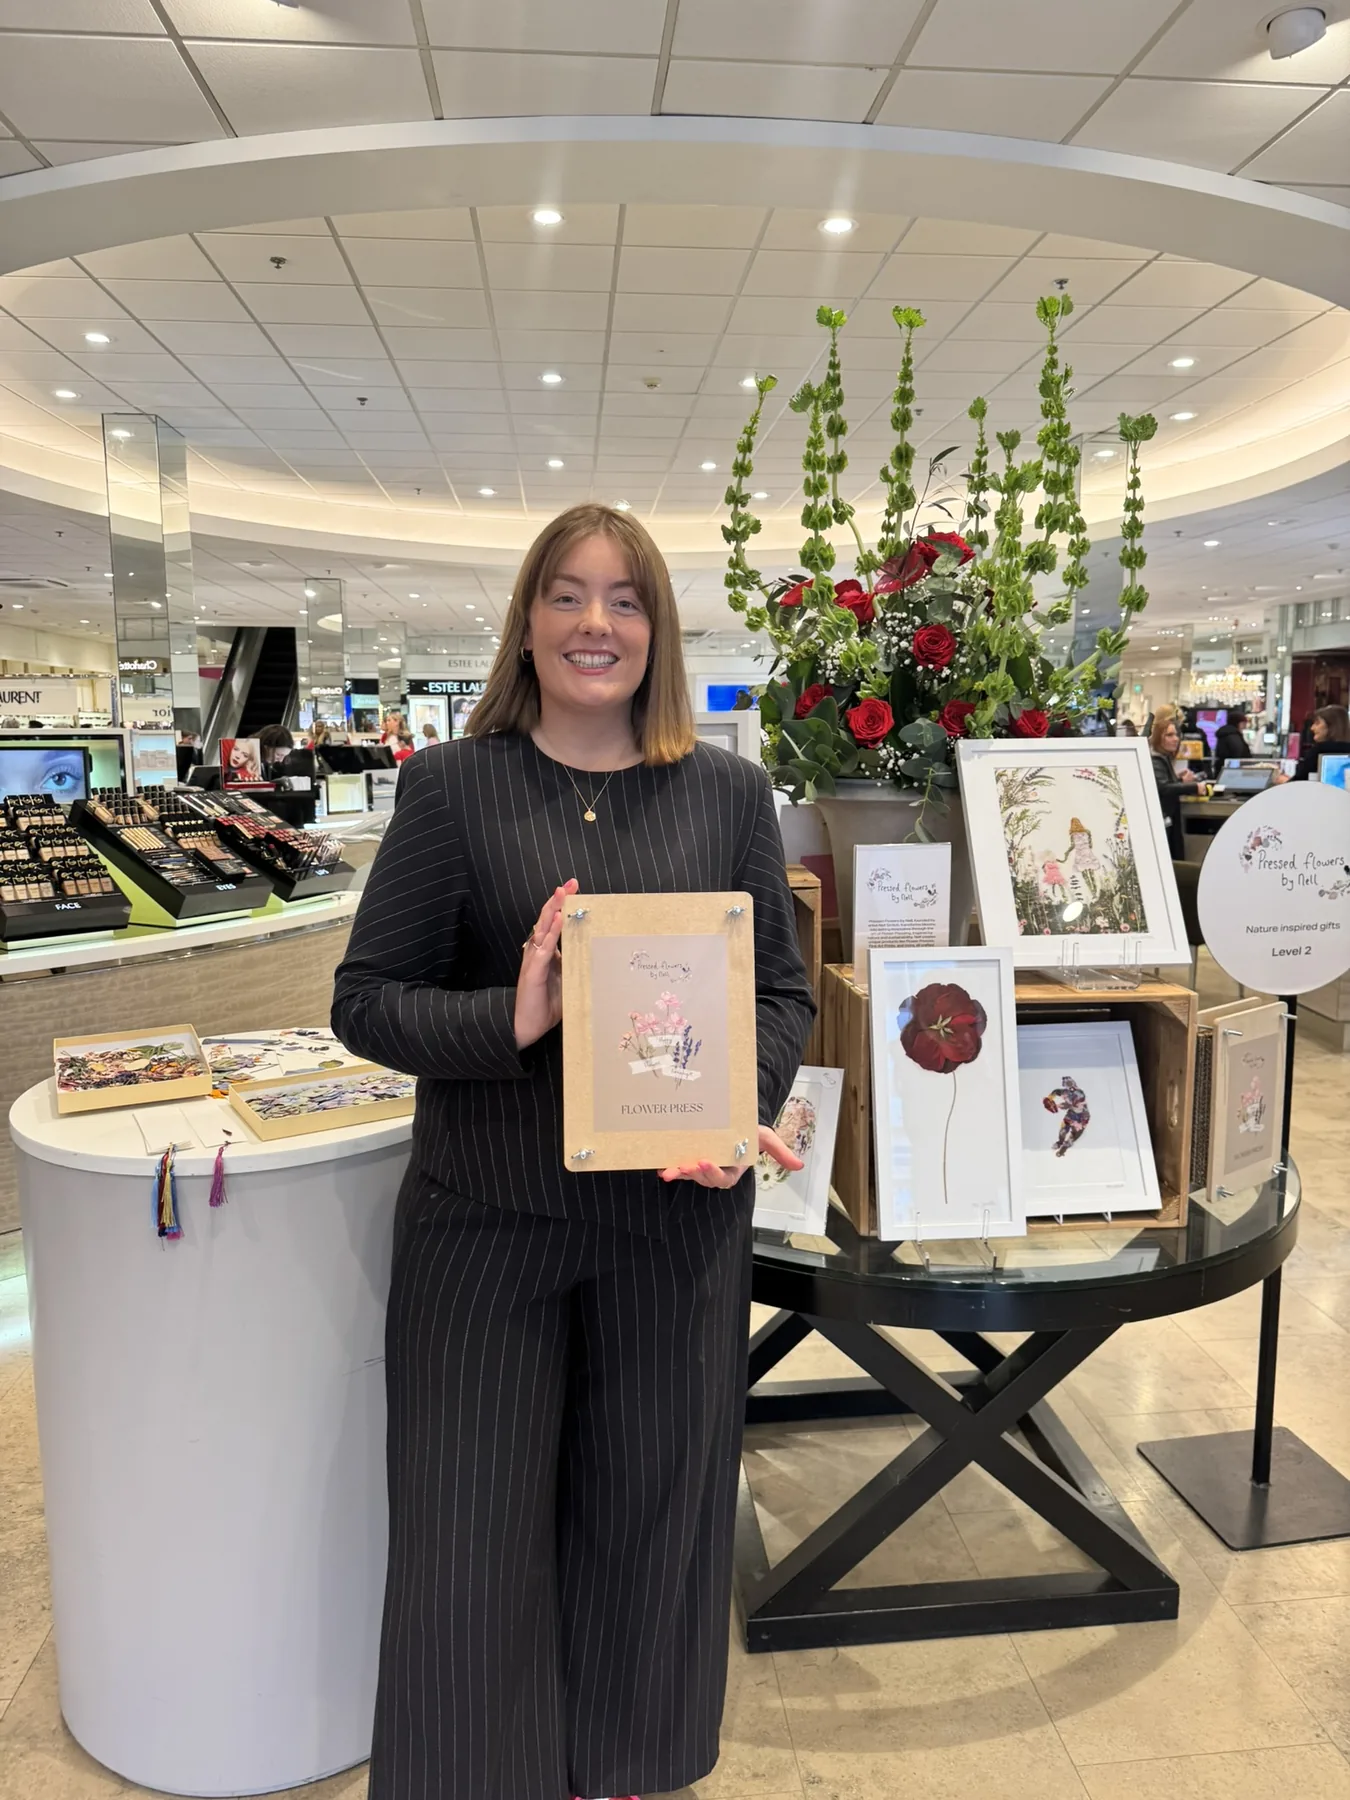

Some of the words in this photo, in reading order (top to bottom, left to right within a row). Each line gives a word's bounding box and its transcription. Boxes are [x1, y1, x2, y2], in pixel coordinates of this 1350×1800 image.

[1257, 850, 1297, 870] Pressed
[1303, 852, 1345, 871] flowers
[215, 883, 237, 891] EYES
[877, 881, 900, 892] Pressed
[1281, 874, 1294, 891] by
[891, 894, 900, 903] by
[54, 902, 82, 910] FACE
[1246, 924, 1279, 934] Nature
[1280, 922, 1318, 935] inspired
[1319, 921, 1341, 933] gifts
[1272, 946, 1302, 958] Level
[1304, 946, 1312, 955] 2
[650, 970, 658, 980] by
[621, 1103, 668, 1115] FLOWER
[669, 1102, 704, 1113] PRESS
